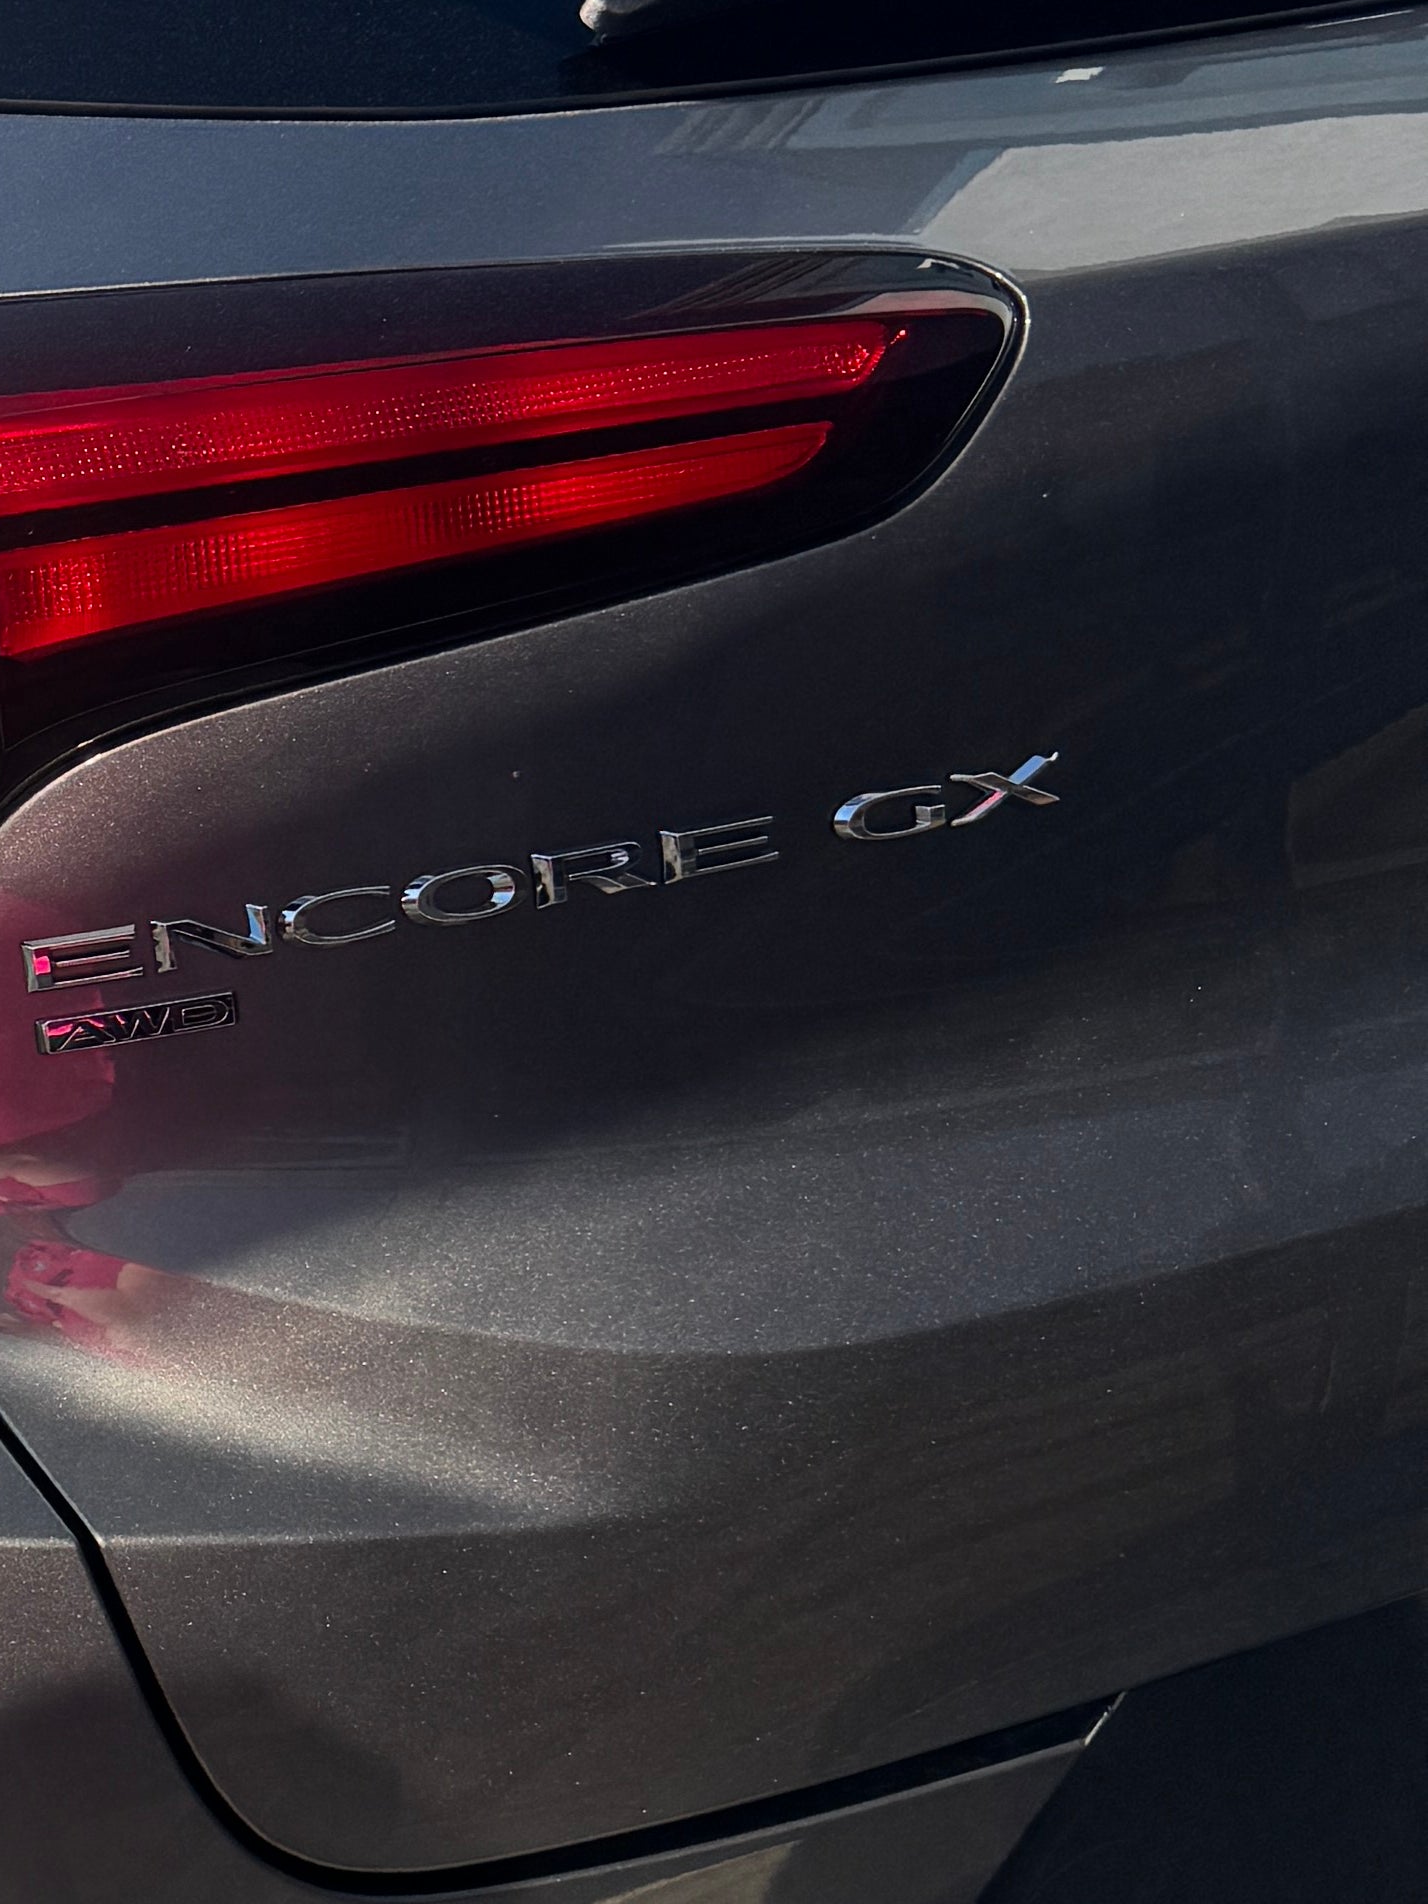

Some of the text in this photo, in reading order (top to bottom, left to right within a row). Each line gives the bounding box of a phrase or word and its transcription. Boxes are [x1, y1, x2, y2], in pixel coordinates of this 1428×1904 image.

[20, 749, 1061, 994] ENCORE GX
[52, 997, 233, 1052] AWD
